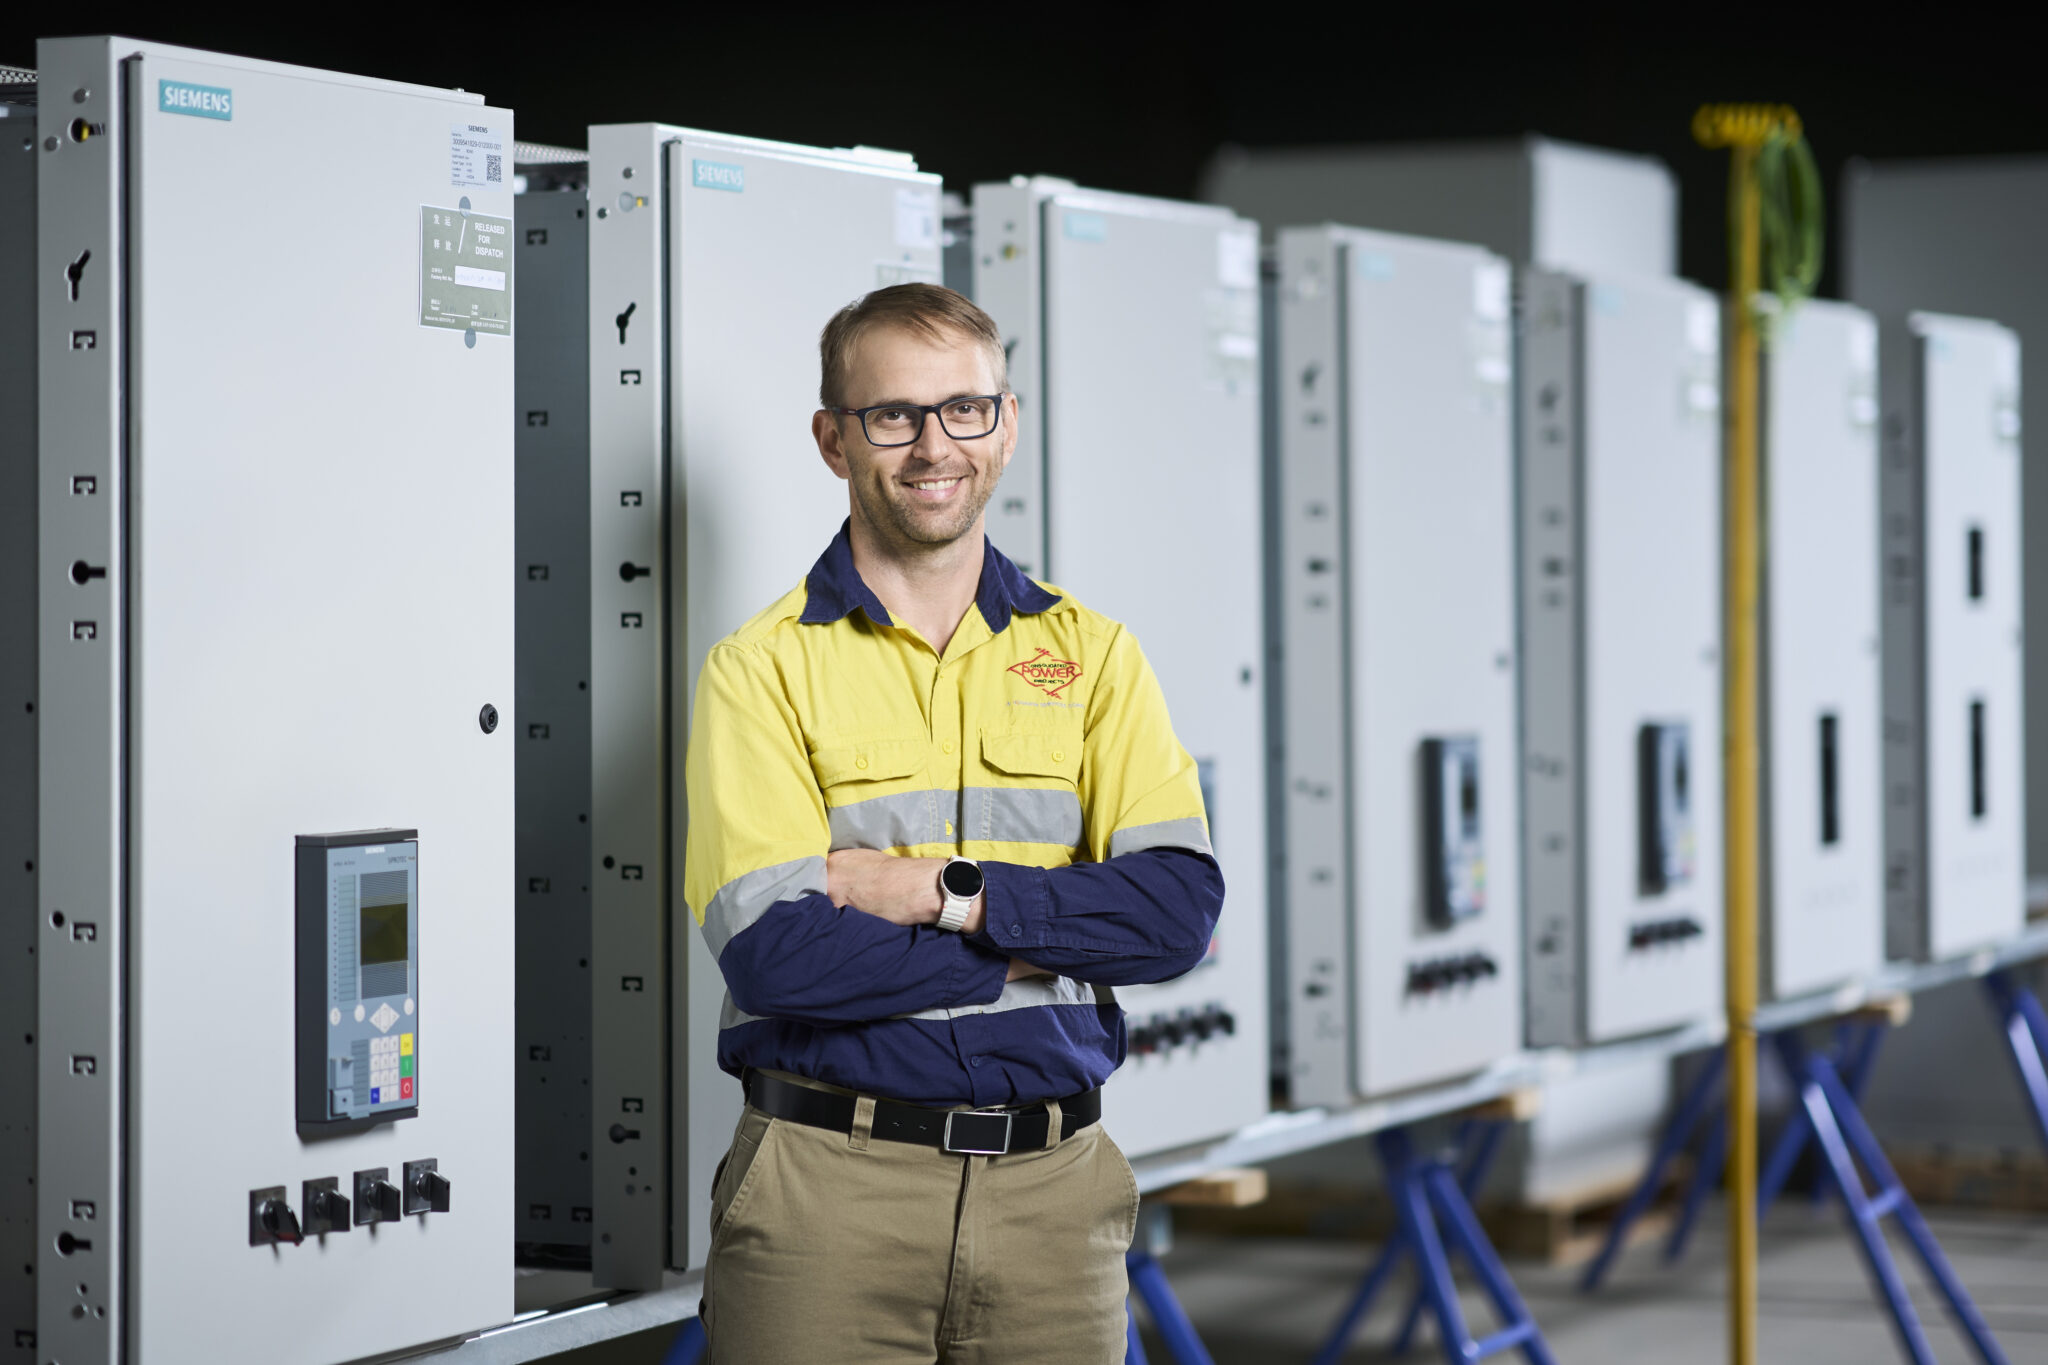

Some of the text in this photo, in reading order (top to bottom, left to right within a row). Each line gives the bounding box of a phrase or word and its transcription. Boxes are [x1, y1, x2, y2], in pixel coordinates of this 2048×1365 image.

[164, 86, 231, 113] SIEMENS
[468, 124, 488, 134] SIEMENS
[474, 222, 505, 235] RELEASED
[478, 234, 491, 245] FOR
[475, 246, 504, 259] DISPATCH
[1021, 664, 1076, 679] POWER
